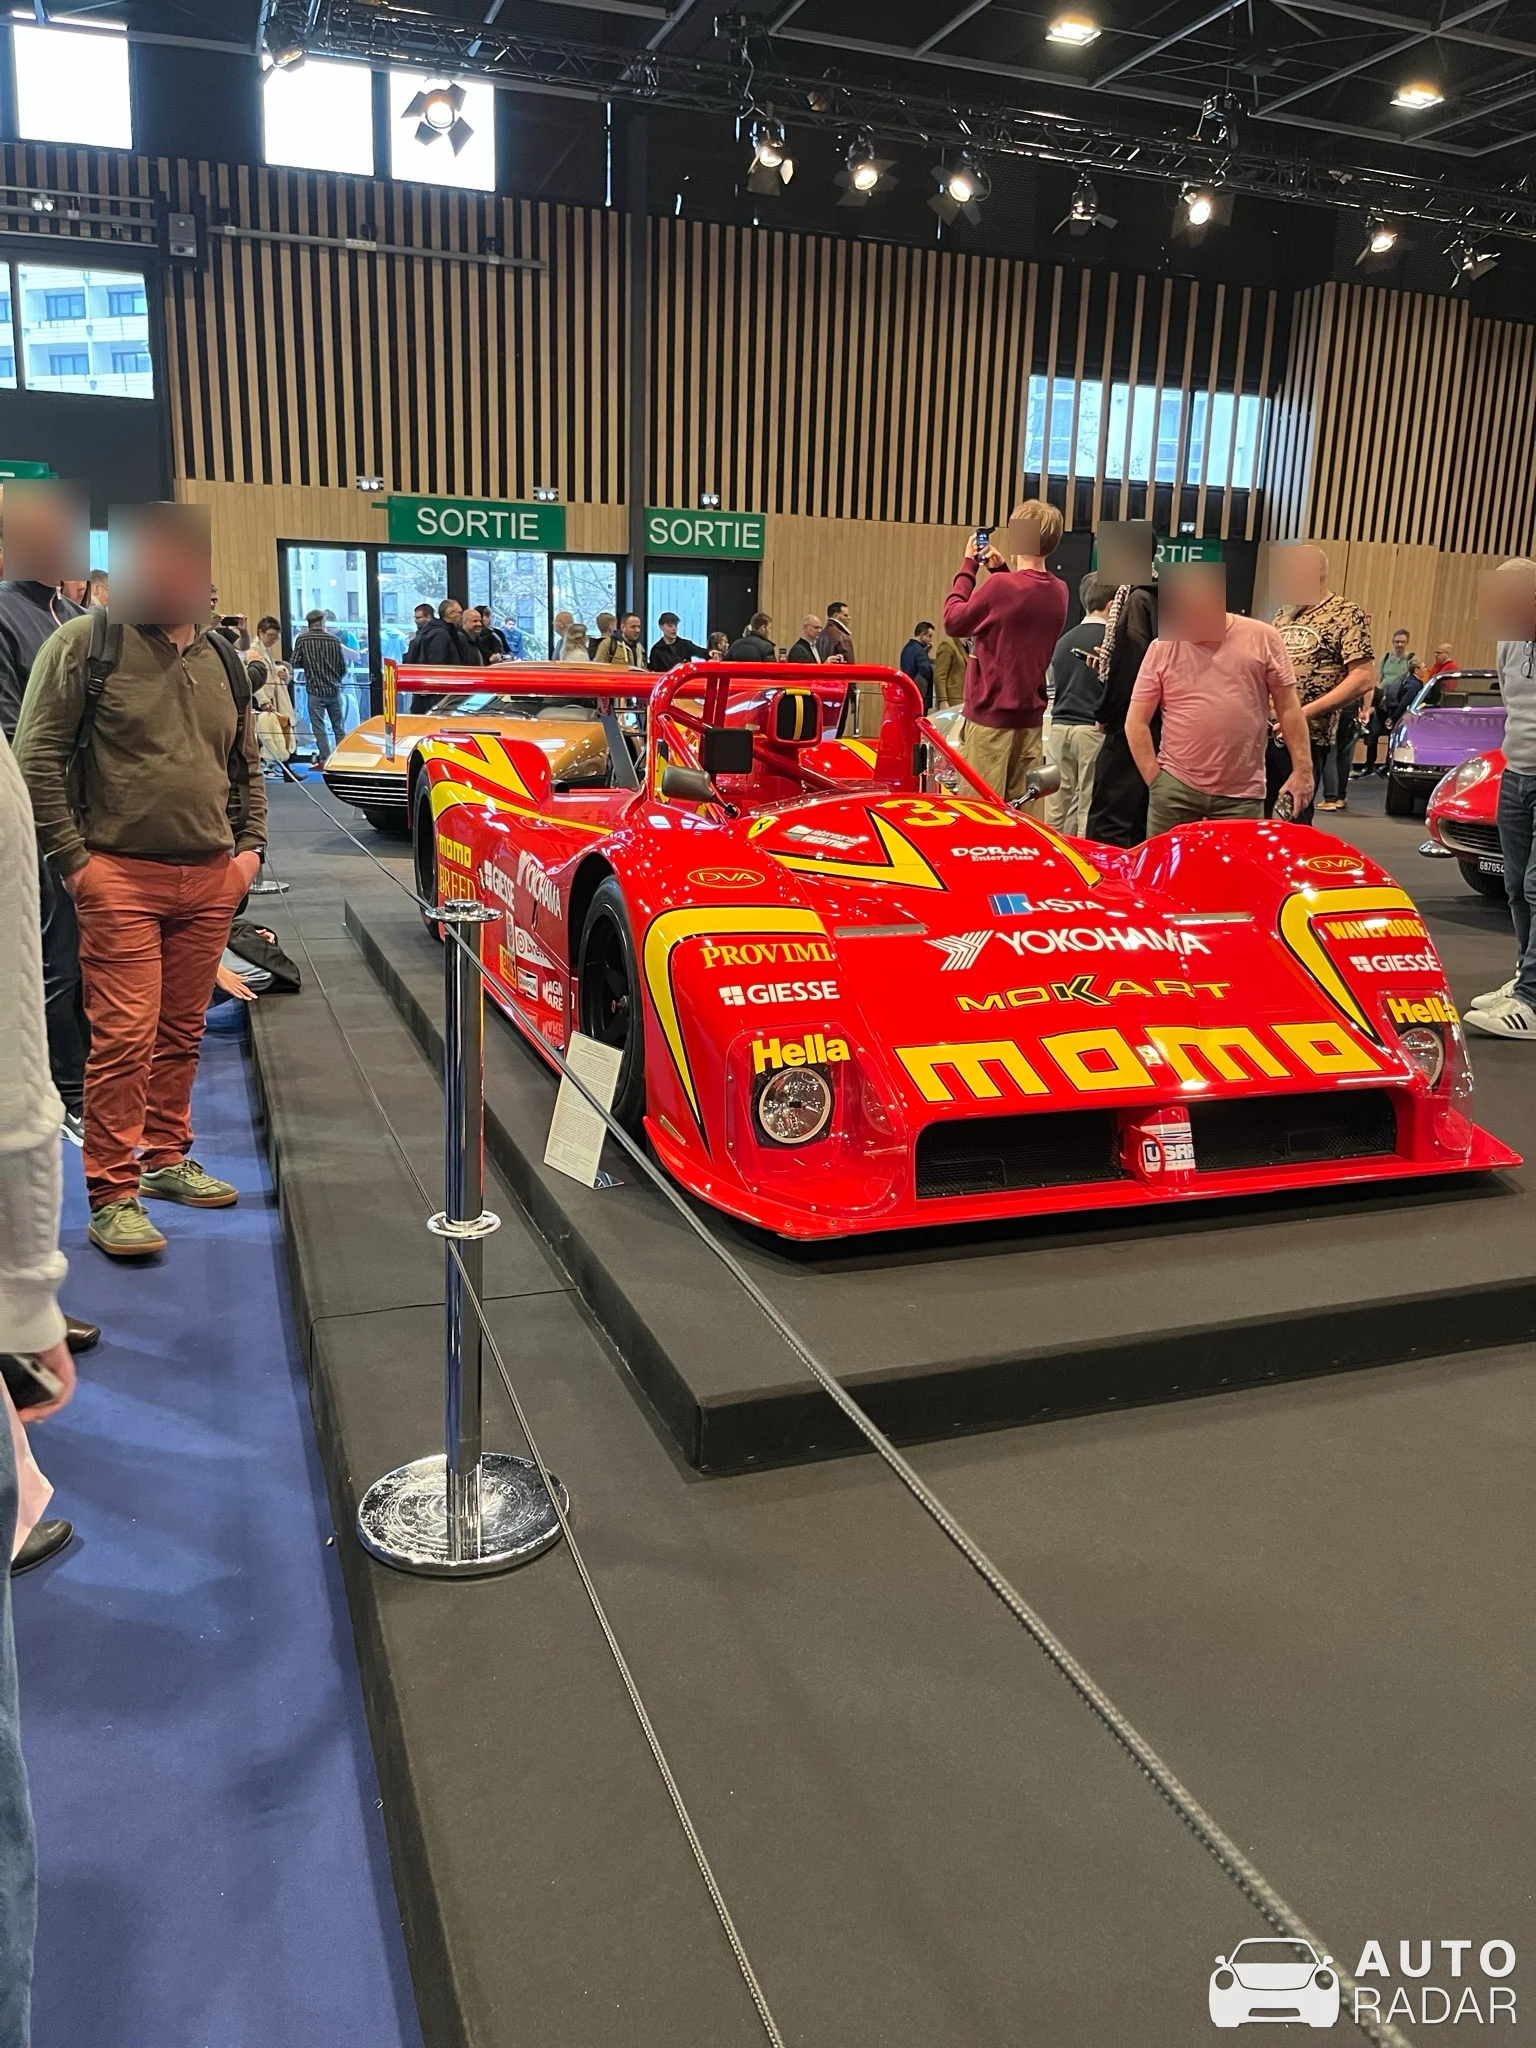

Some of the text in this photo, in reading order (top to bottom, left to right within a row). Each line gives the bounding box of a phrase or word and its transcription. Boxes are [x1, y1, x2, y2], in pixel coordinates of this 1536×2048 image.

[417, 507, 540, 541] SORTIE
[649, 517, 761, 549] SORTIE
[880, 799, 1018, 827] 30
[951, 847, 1040, 857] DORAN
[971, 853, 1034, 862] Enterprises
[437, 864, 477, 901] BREED
[1021, 898, 1105, 914] LISTA
[996, 927, 1212, 955] YOKOHAMA
[699, 943, 835, 969] PROVIMI
[1371, 954, 1442, 973] GIESSE
[746, 980, 841, 1006] GIESSE
[955, 974, 1233, 1012] MOKART
[1386, 997, 1460, 1024] Hella
[752, 1034, 851, 1075] Hella
